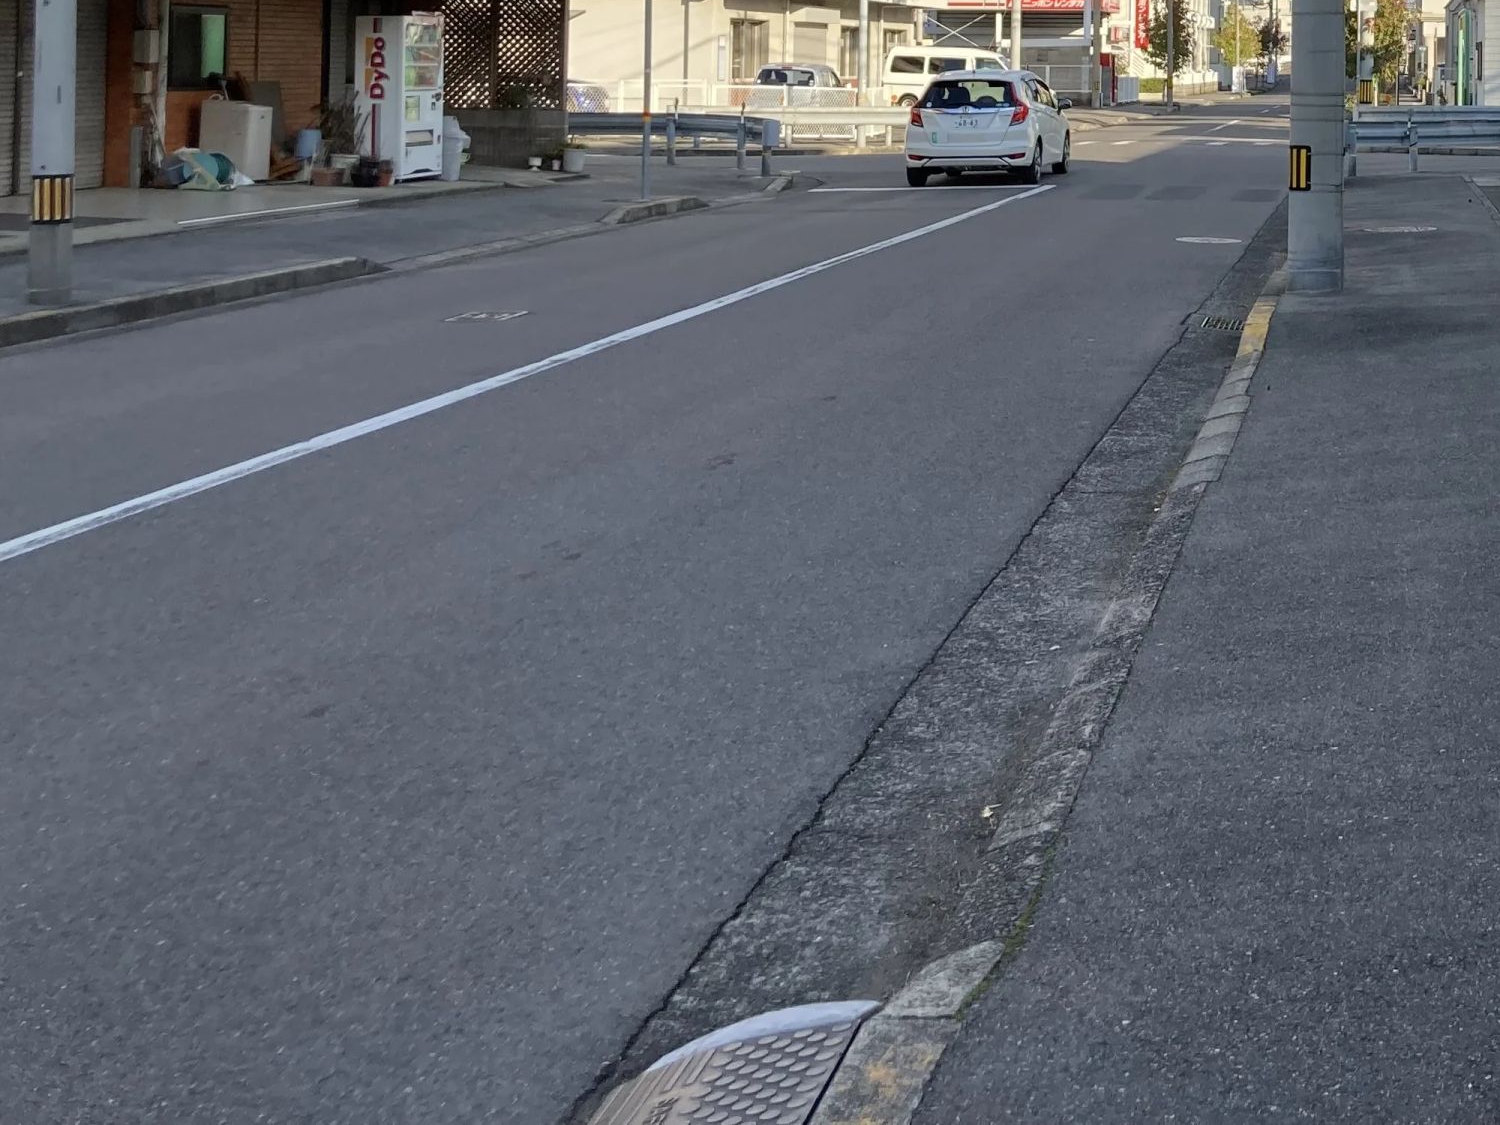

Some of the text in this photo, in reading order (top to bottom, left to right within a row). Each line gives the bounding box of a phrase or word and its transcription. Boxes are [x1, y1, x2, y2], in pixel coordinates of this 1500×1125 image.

[1022, 0, 1085, 8] ニッポンレンタカ
[369, 36, 390, 100] DyDo
